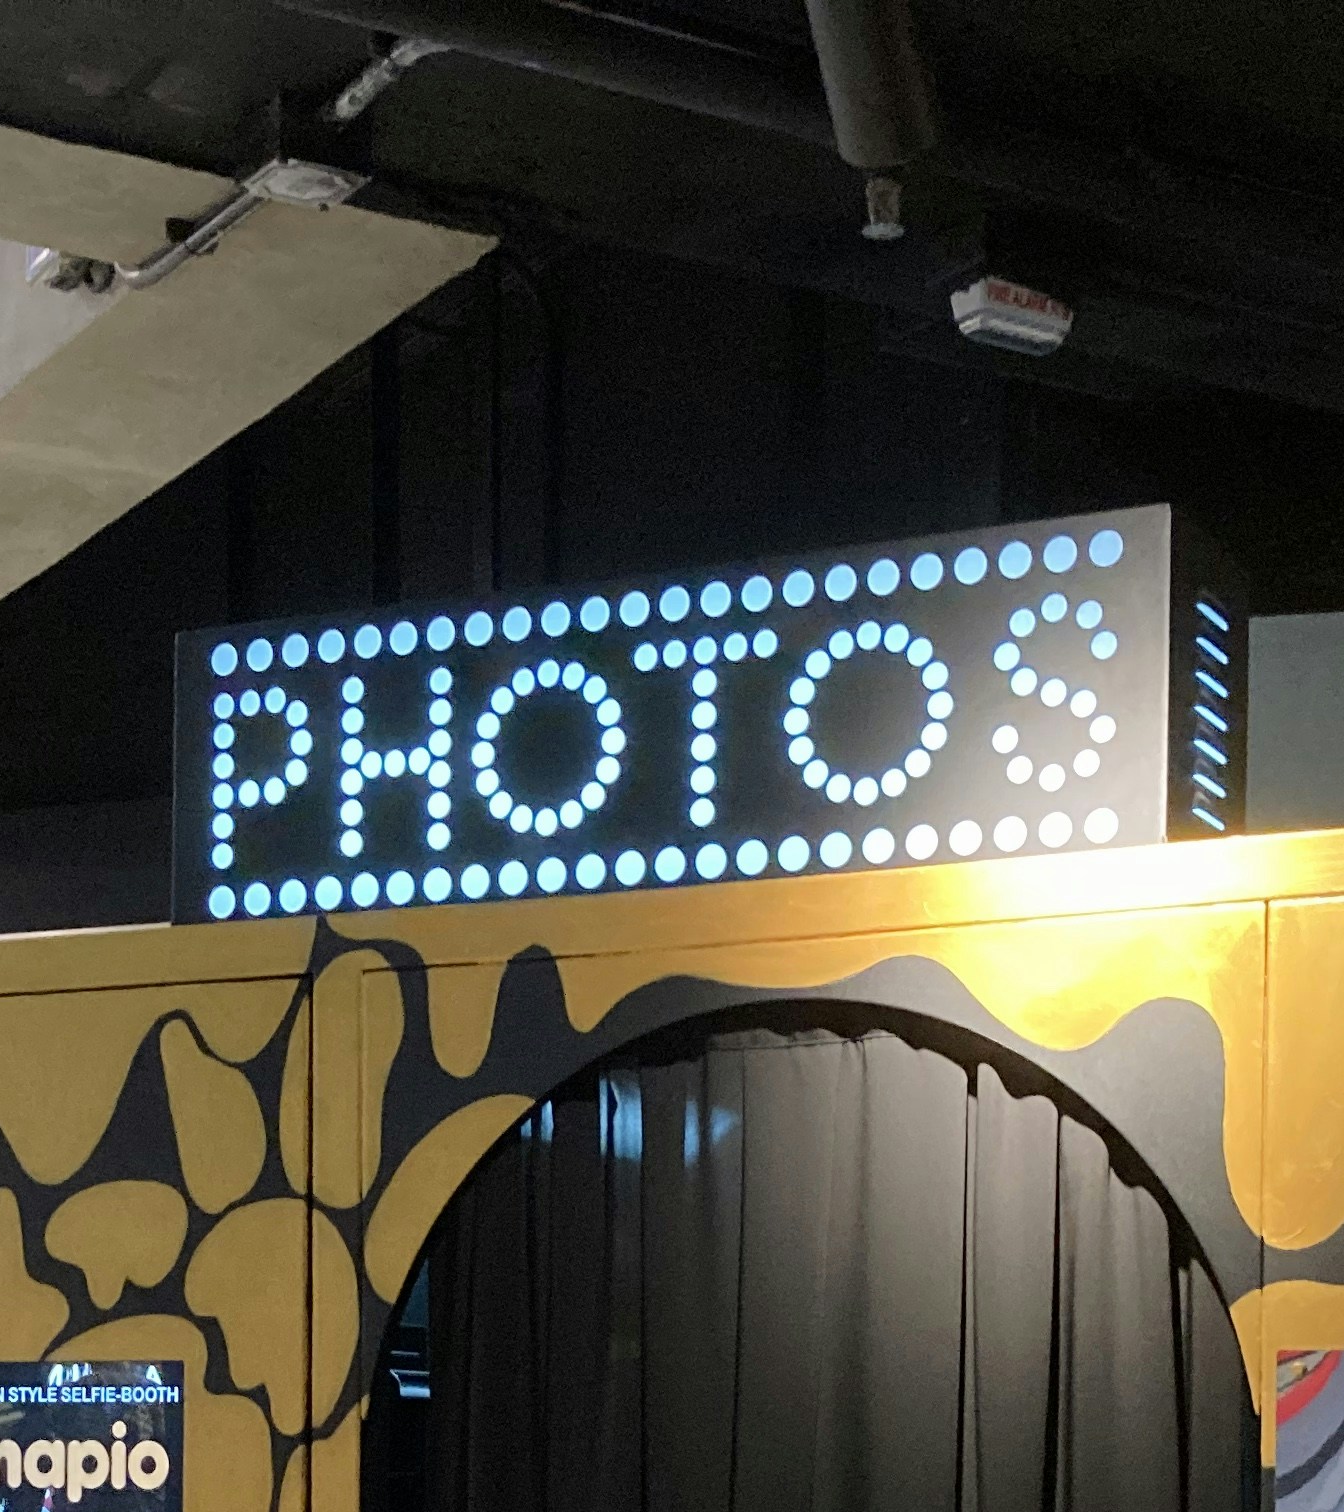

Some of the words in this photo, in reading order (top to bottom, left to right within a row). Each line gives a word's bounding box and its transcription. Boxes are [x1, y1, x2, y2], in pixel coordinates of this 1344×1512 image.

[213, 592, 1119, 871] PHOTOS
[8, 1387, 58, 1403] STYLE
[61, 1387, 179, 1403] SELFIE-BOOTH
